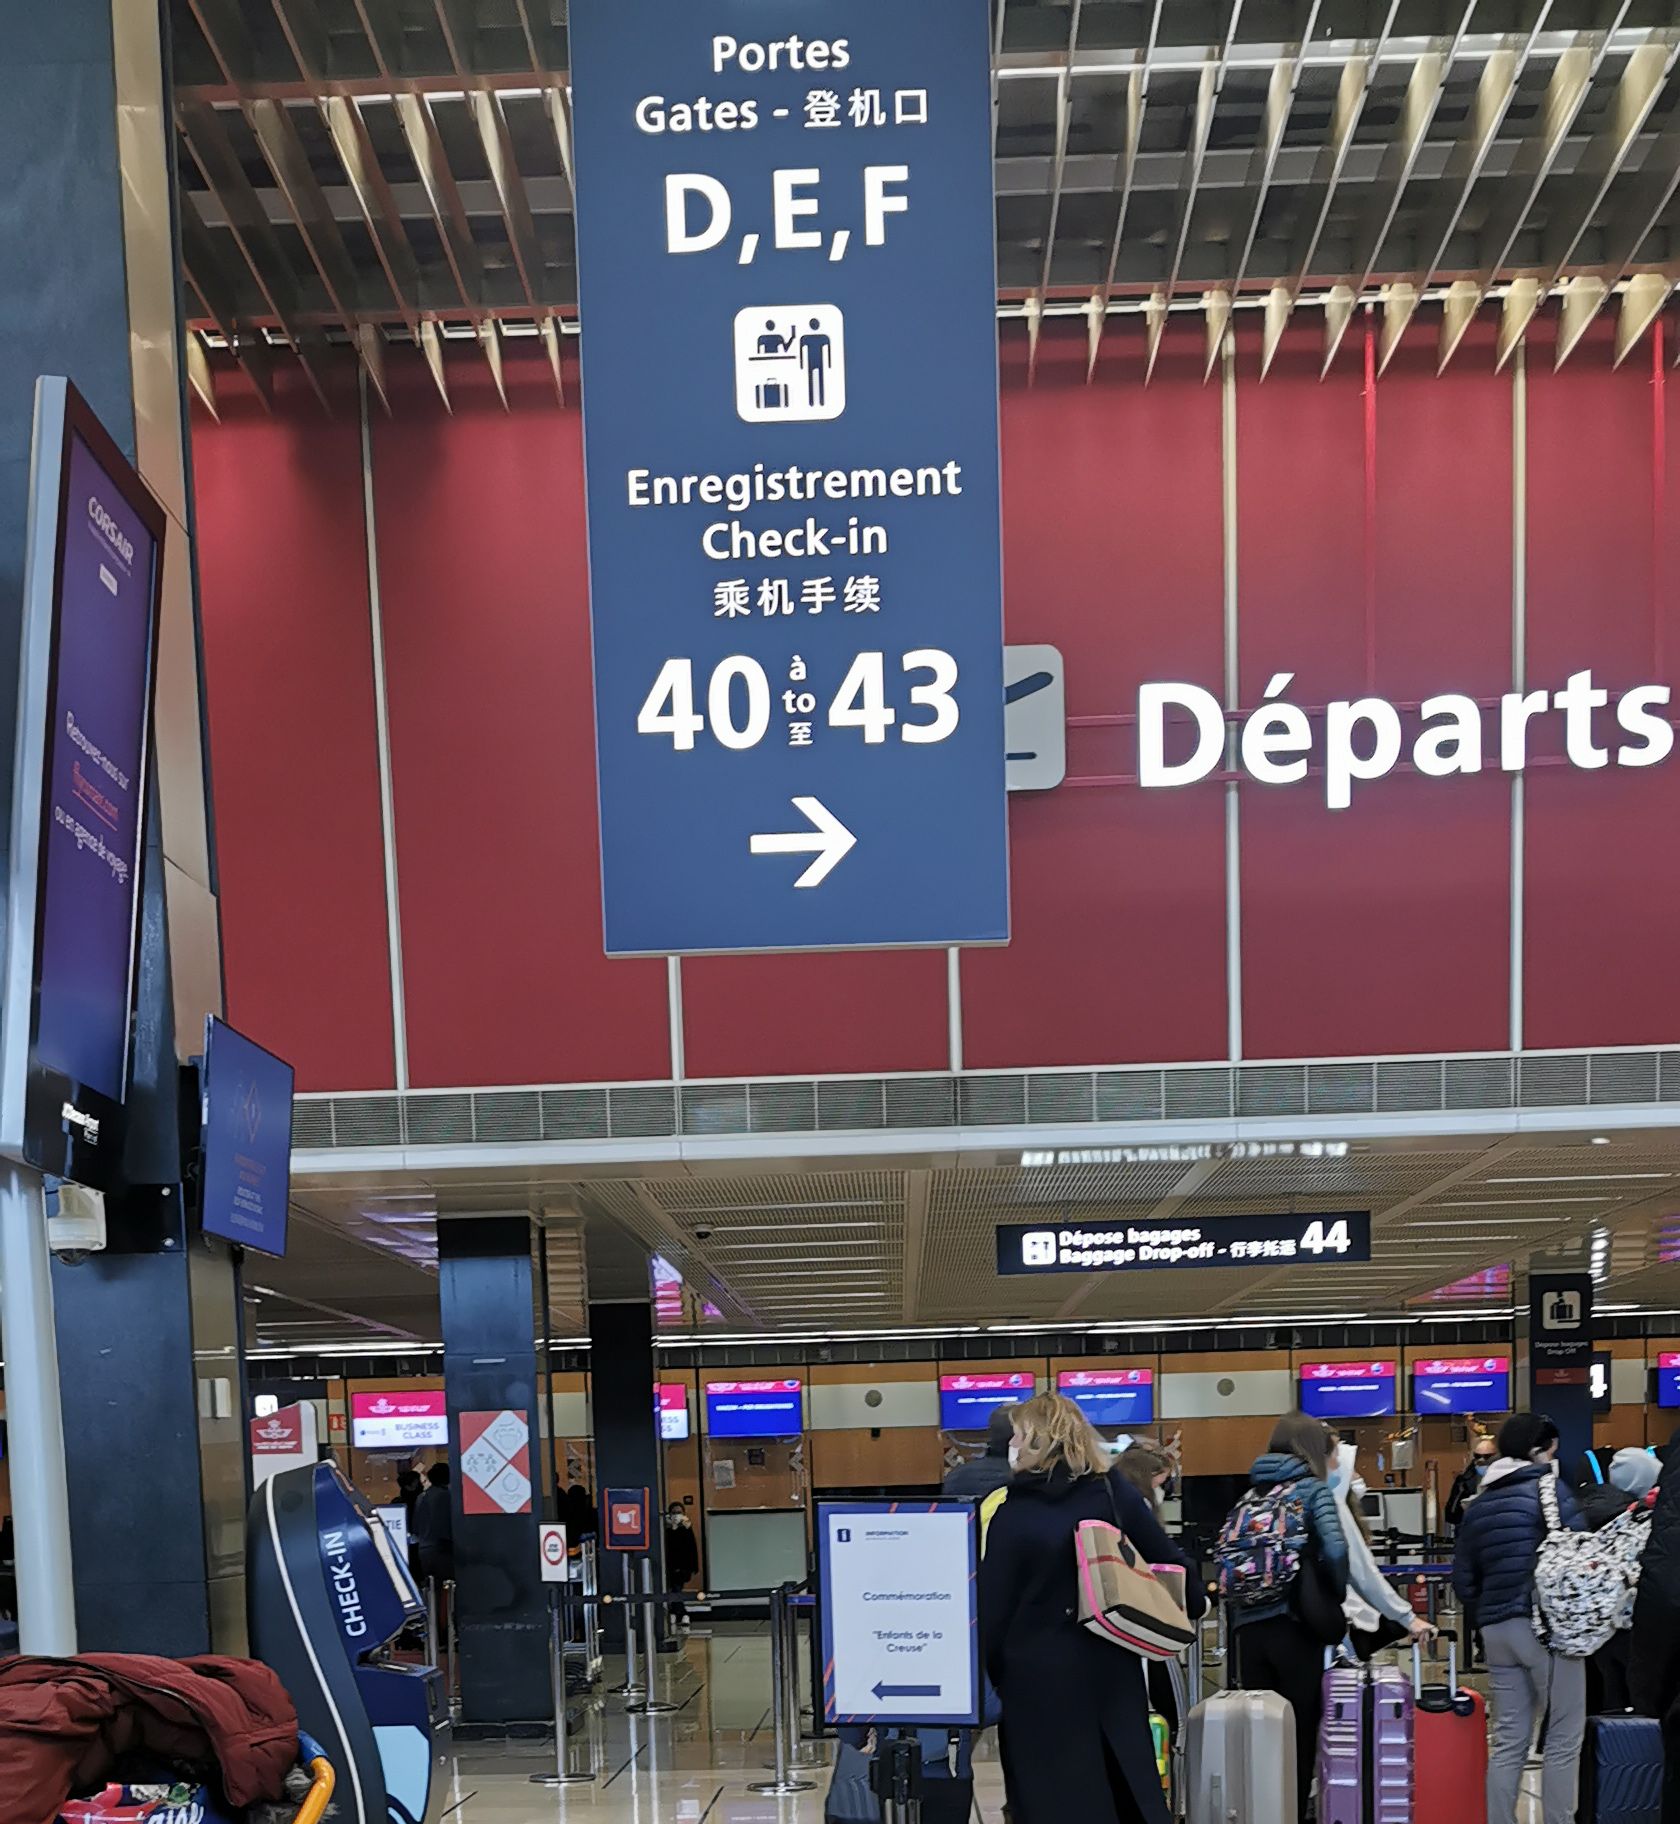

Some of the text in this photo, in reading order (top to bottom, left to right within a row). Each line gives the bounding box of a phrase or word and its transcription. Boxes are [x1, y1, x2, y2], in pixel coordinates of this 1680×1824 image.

[713, 35, 849, 72] Portes
[636, 96, 758, 132] Gates
[804, 88, 927, 127] 登机口
[666, 166, 908, 264] D,E,F
[628, 461, 962, 511] Enregistrement
[88, 496, 134, 566] CORSAIR
[703, 517, 886, 559] Check-in
[714, 575, 880, 617] 乘机手续
[790, 655, 806, 680] à
[638, 655, 770, 750] 40
[782, 690, 815, 713] to
[829, 649, 958, 743] 43
[789, 722, 813, 745] 至
[1140, 670, 1673, 809] Départs
[1060, 1228, 1202, 1248] Dépose bagages
[1060, 1248, 1135, 1265] Baggage
[1139, 1240, 1214, 1262] Drop-off
[1301, 1221, 1350, 1253] 44
[395, 1422, 440, 1431] BUSINESS
[403, 1431, 432, 1439] CLASS
[386, 1519, 402, 1530] TIE
[323, 1531, 367, 1637] CHECK-IN
[863, 1591, 951, 1601] Commémoration
[915, 1630, 931, 1640] de
[932, 1630, 943, 1640] la
